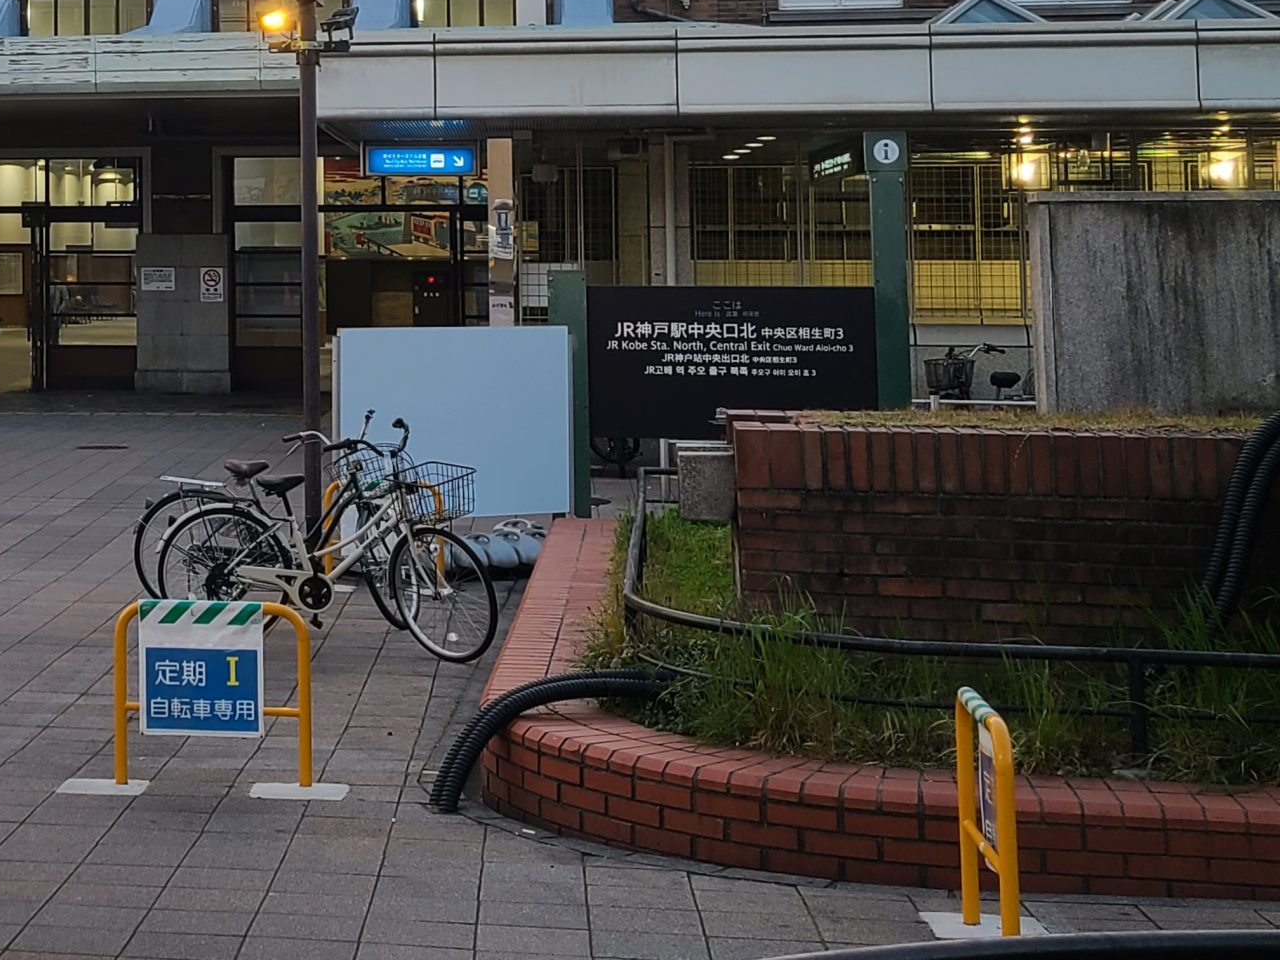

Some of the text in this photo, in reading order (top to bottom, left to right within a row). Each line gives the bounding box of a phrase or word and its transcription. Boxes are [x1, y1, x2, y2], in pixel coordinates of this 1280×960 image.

[615, 321, 844, 340] JR神戸駅中央口北 中央区相生町3
[606, 340, 619, 350] JR
[621, 340, 648, 350] Kobe
[650, 340, 671, 350] Sta.
[673, 340, 707, 352] North,
[709, 340, 748, 351] Central
[750, 341, 771, 351] Exit
[772, 343, 793, 352] Chuo
[794, 343, 814, 352] Ward
[848, 344, 854, 352] 3
[155, 659, 206, 687] 定期
[150, 697, 255, 721] 自転車専用
